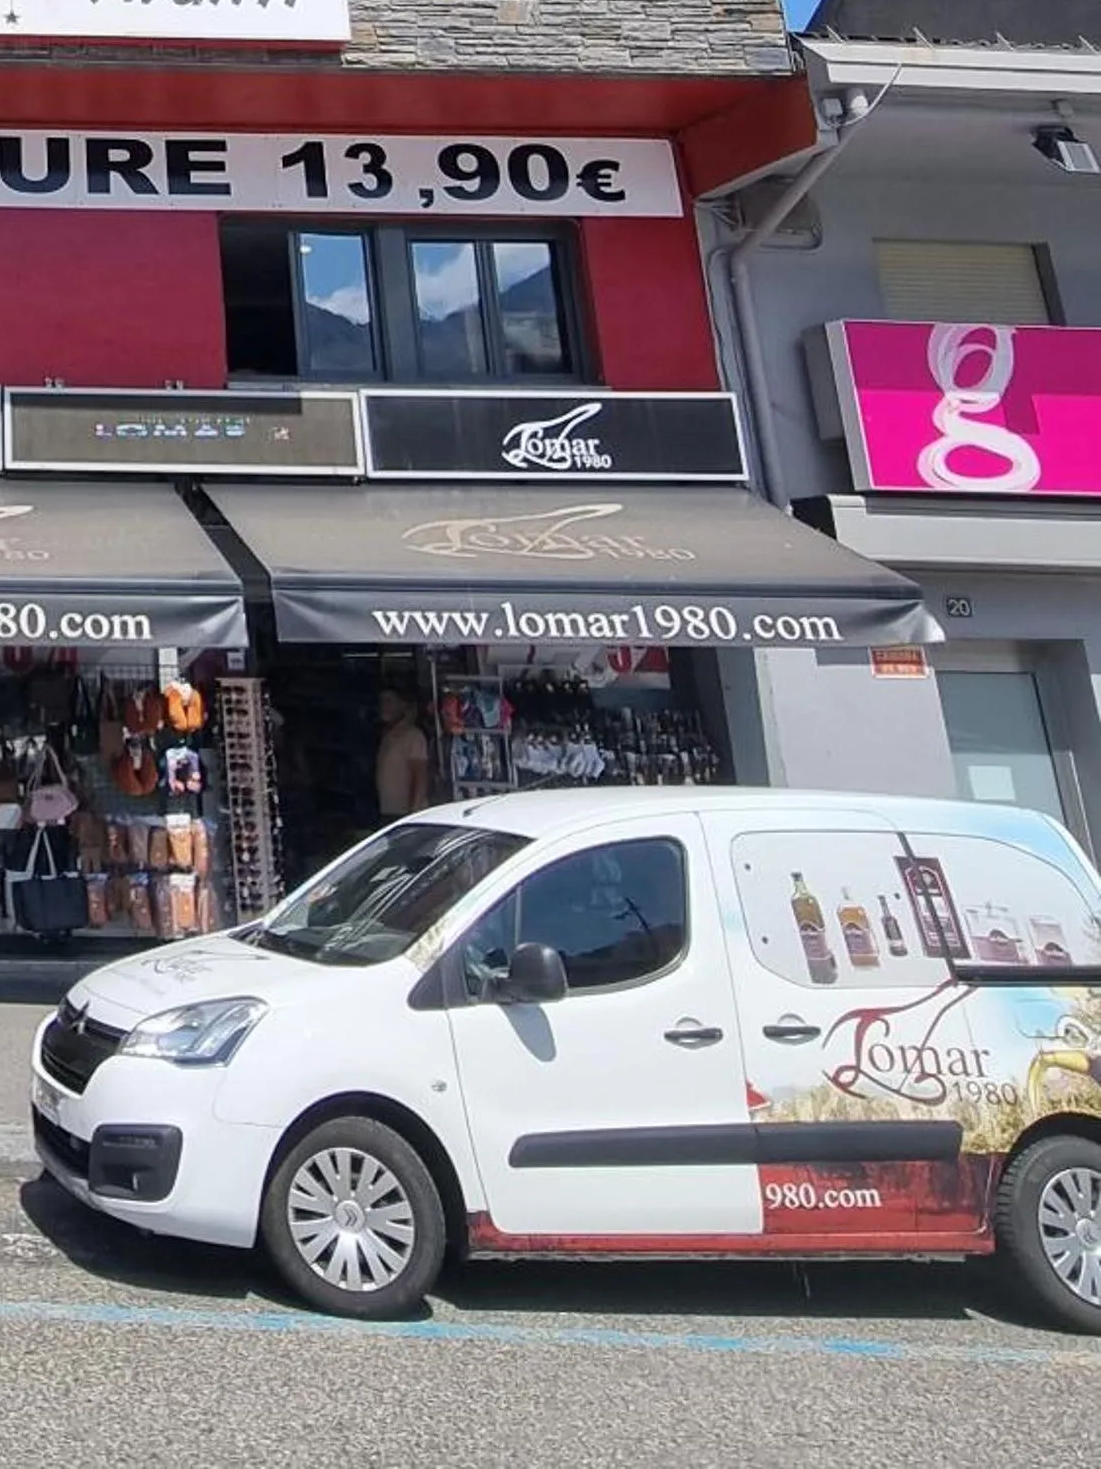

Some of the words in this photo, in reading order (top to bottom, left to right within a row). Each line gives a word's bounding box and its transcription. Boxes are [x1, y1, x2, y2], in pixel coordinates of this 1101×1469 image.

[279, 140, 626, 209] 13,90€
[573, 454, 612, 469] 1980
[949, 599, 970, 616] 20
[373, 602, 843, 642] www.lomar1980.com
[822, 981, 991, 1106] Lomar
[953, 1080, 1019, 1105] 1980
[765, 1183, 882, 1210] 980.com
